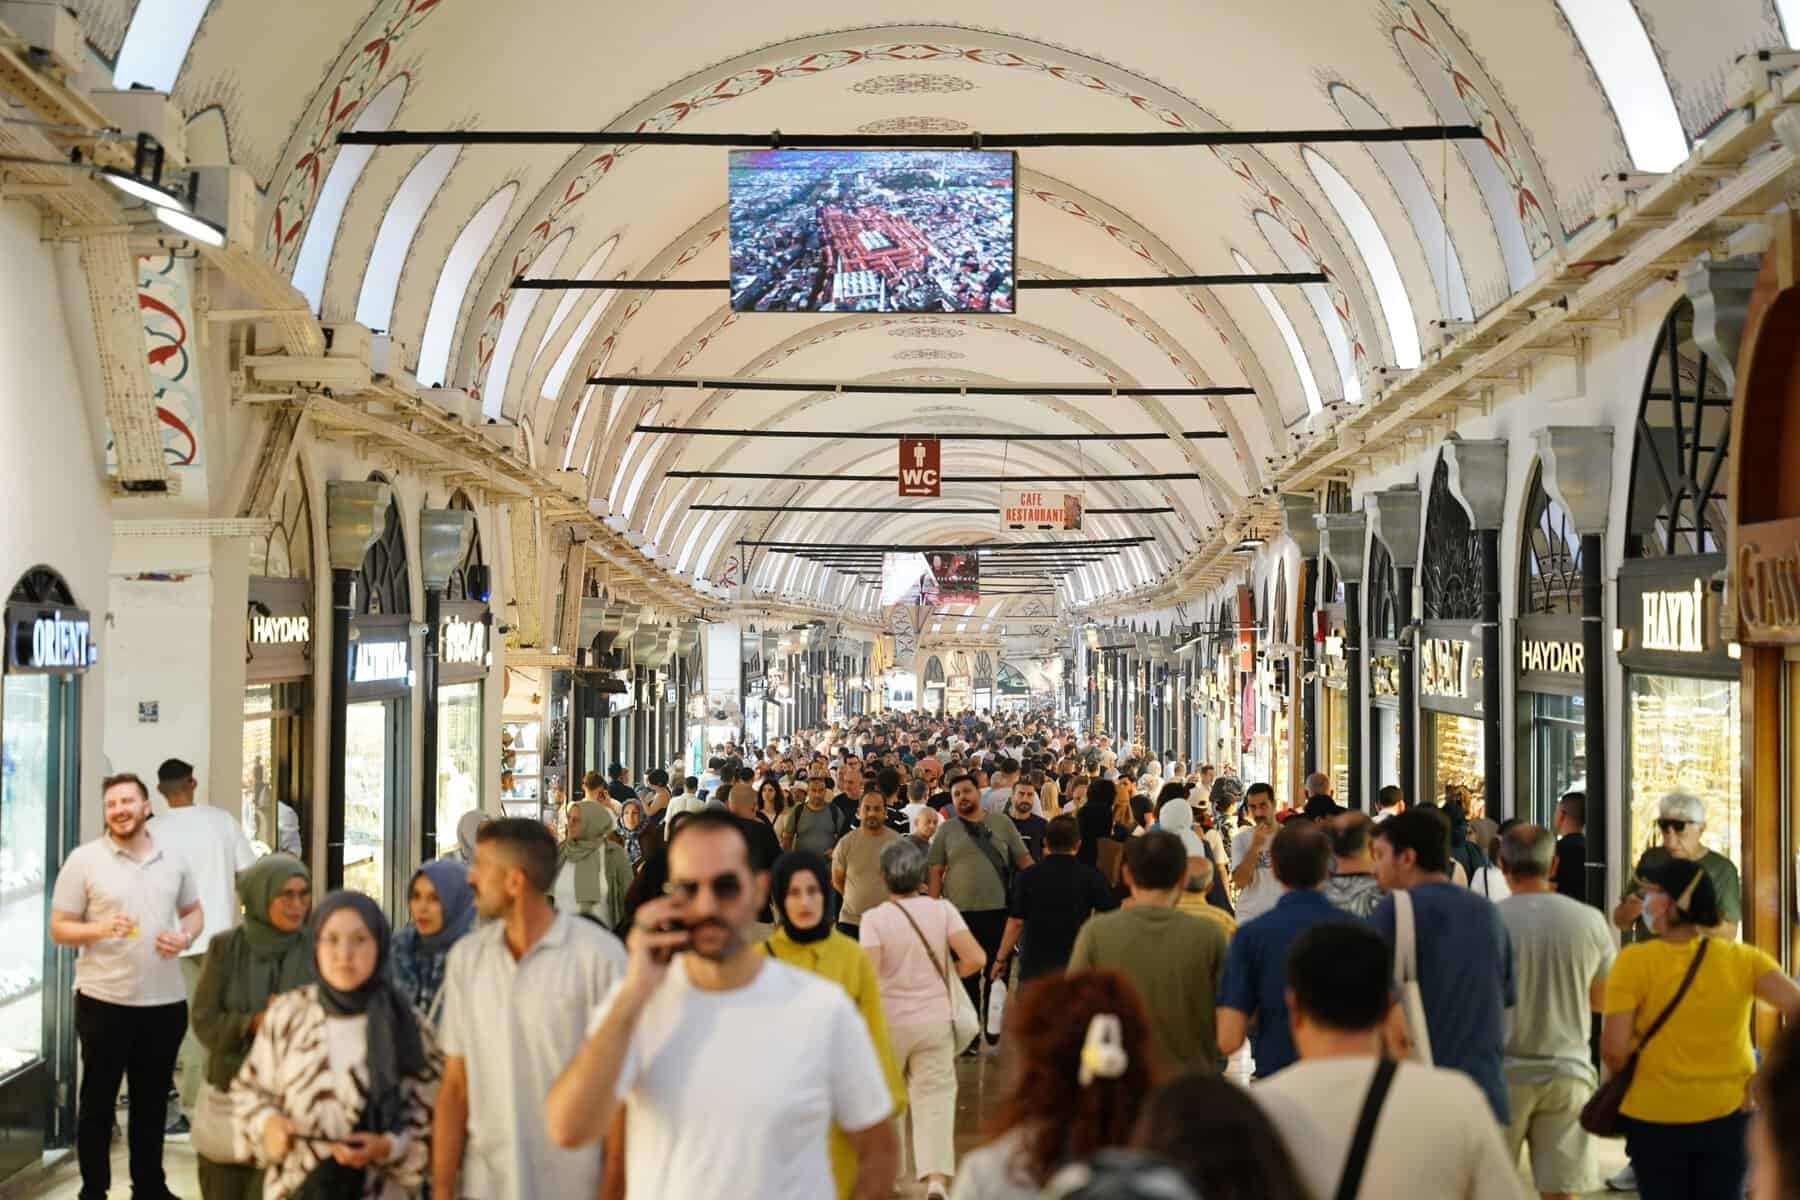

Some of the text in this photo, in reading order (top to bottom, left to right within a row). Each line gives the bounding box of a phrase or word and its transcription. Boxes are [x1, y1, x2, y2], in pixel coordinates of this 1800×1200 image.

[902, 469, 937, 486] WC
[1006, 509, 1064, 522] RESTAURANT
[1642, 578, 1703, 652] HAYRİ
[254, 616, 309, 643] HAYDAR
[1522, 640, 1584, 674] HAYDAR
